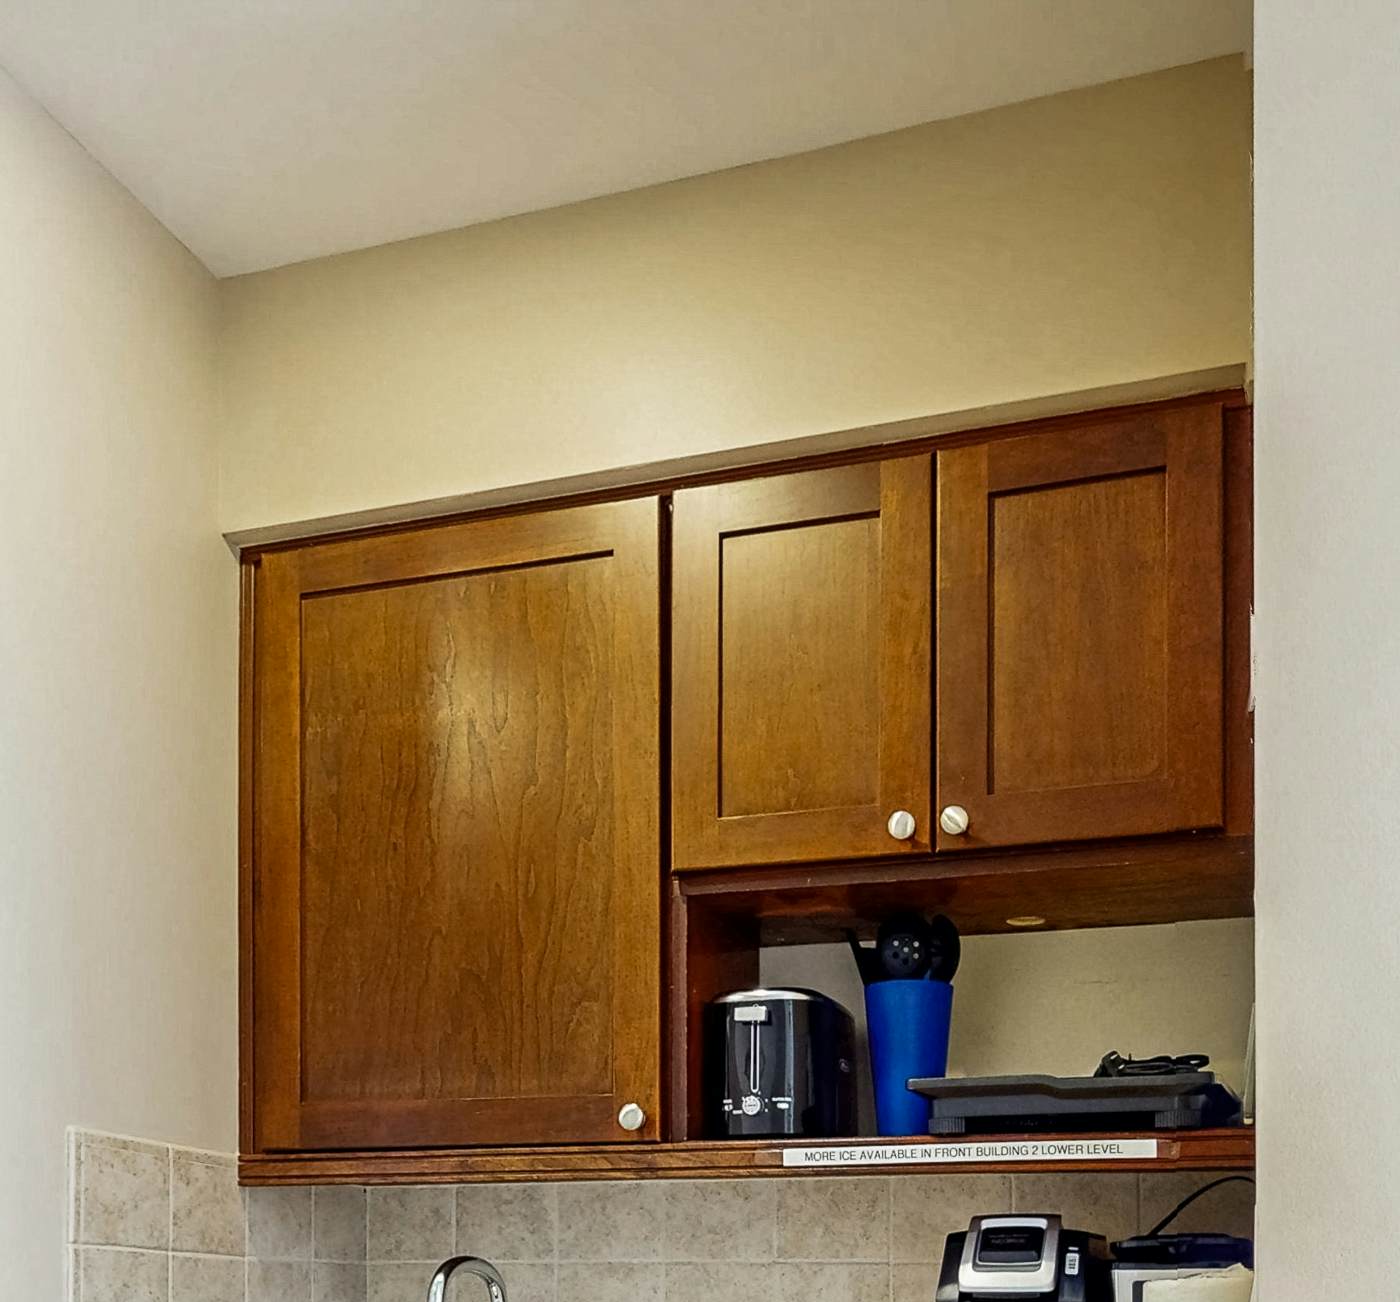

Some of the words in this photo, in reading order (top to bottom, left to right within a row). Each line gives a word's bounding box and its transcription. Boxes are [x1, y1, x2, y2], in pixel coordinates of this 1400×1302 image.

[804, 1150, 836, 1162] MORE
[839, 1150, 857, 1161] ICE
[859, 1148, 917, 1161] AVAILABLE
[920, 1148, 932, 1159] IN
[935, 1147, 973, 1158] FRONT
[976, 1145, 1029, 1157] BUILDING
[1031, 1144, 1039, 1156] 2
[1041, 1144, 1084, 1155] LOWER
[1087, 1143, 1124, 1154] LEVEL
